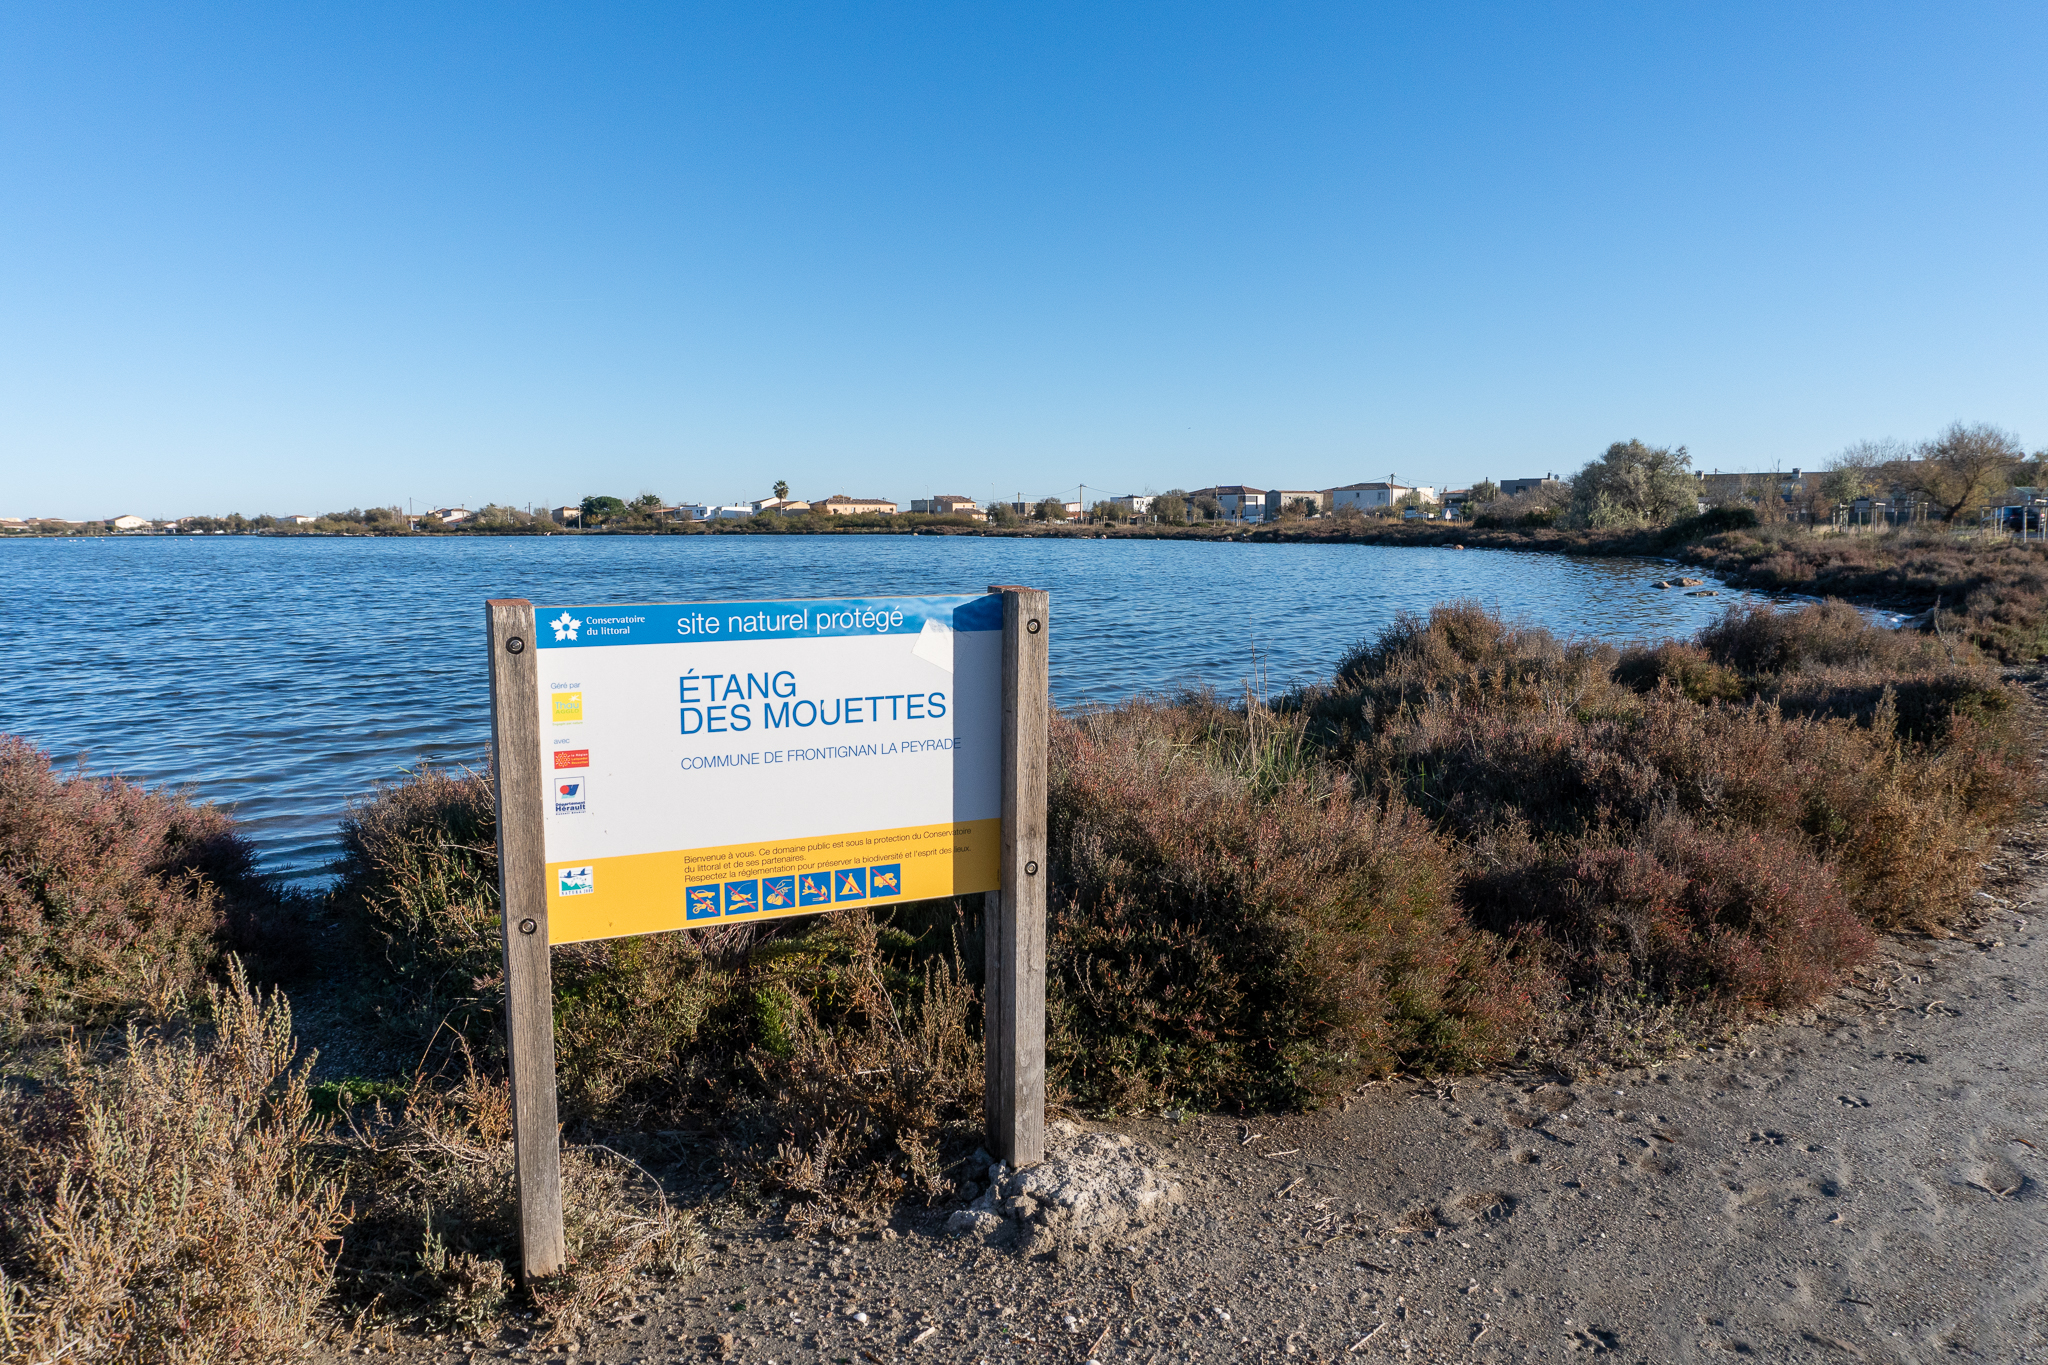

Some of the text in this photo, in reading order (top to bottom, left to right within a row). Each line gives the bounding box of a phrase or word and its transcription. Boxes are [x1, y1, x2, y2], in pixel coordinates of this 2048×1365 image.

[586, 615, 645, 625] Conservatoire
[586, 626, 630, 636] du littoral
[677, 605, 904, 635] site naturel protégé
[679, 668, 797, 704] ÉTANG
[555, 701, 580, 709] Thau
[680, 691, 947, 735] DES MOUETTES
[681, 737, 962, 770] COMMUNE DE FRONTIGNAN LA PEYRADE
[684, 827, 972, 864] Bienvenue à vous. Ce domaine public est sous la protection du Conservatoire
[684, 854, 807, 874] du littoral et de ses partenaires.
[684, 845, 972, 884] Respectez la réglementation pour préserver la biodiversité et l'esprit des lieux.
